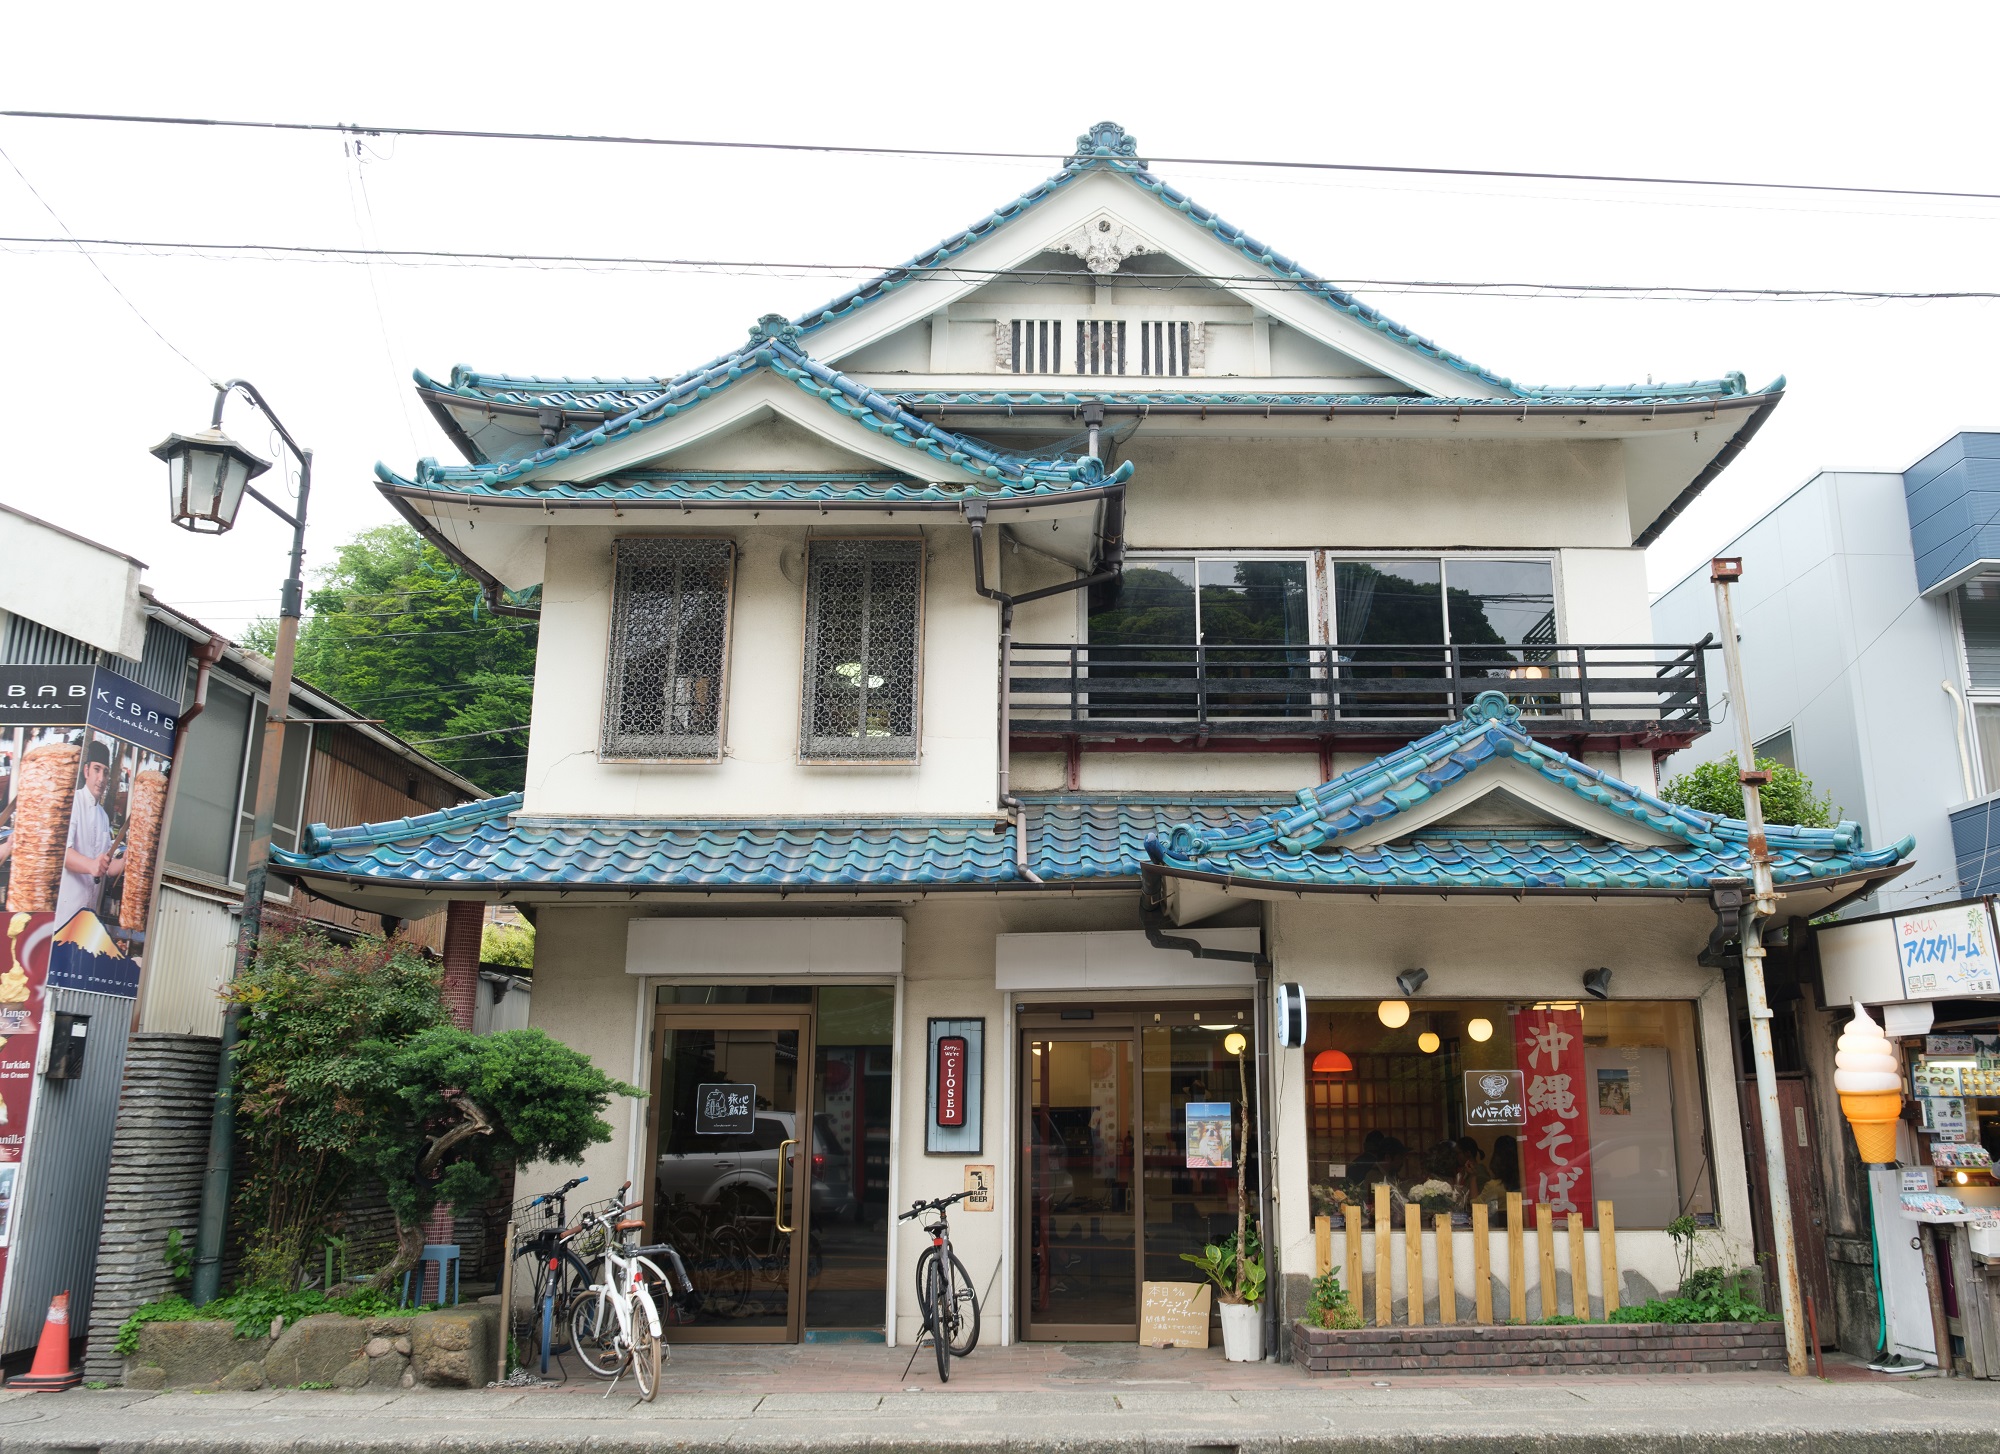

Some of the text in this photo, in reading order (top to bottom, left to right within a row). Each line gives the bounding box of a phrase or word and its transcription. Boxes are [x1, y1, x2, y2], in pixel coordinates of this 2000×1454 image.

[97, 688, 174, 730] KEBAB
[108, 710, 160, 738] Kamakura
[1903, 920, 1938, 936] おいしい
[1903, 932, 1981, 968] アイスクリーム
[49, 970, 139, 988] KEBAB SANDWICH
[1, 1061, 31, 1069] Turkish
[945, 1058, 956, 1118] CLOSED
[1471, 1103, 1522, 1119] バハティ食堂
[1525, 1022, 1584, 1213] 沖縄そば
[1148, 1285, 1169, 1297] 本日
[1146, 1298, 1192, 1310] オープニング
